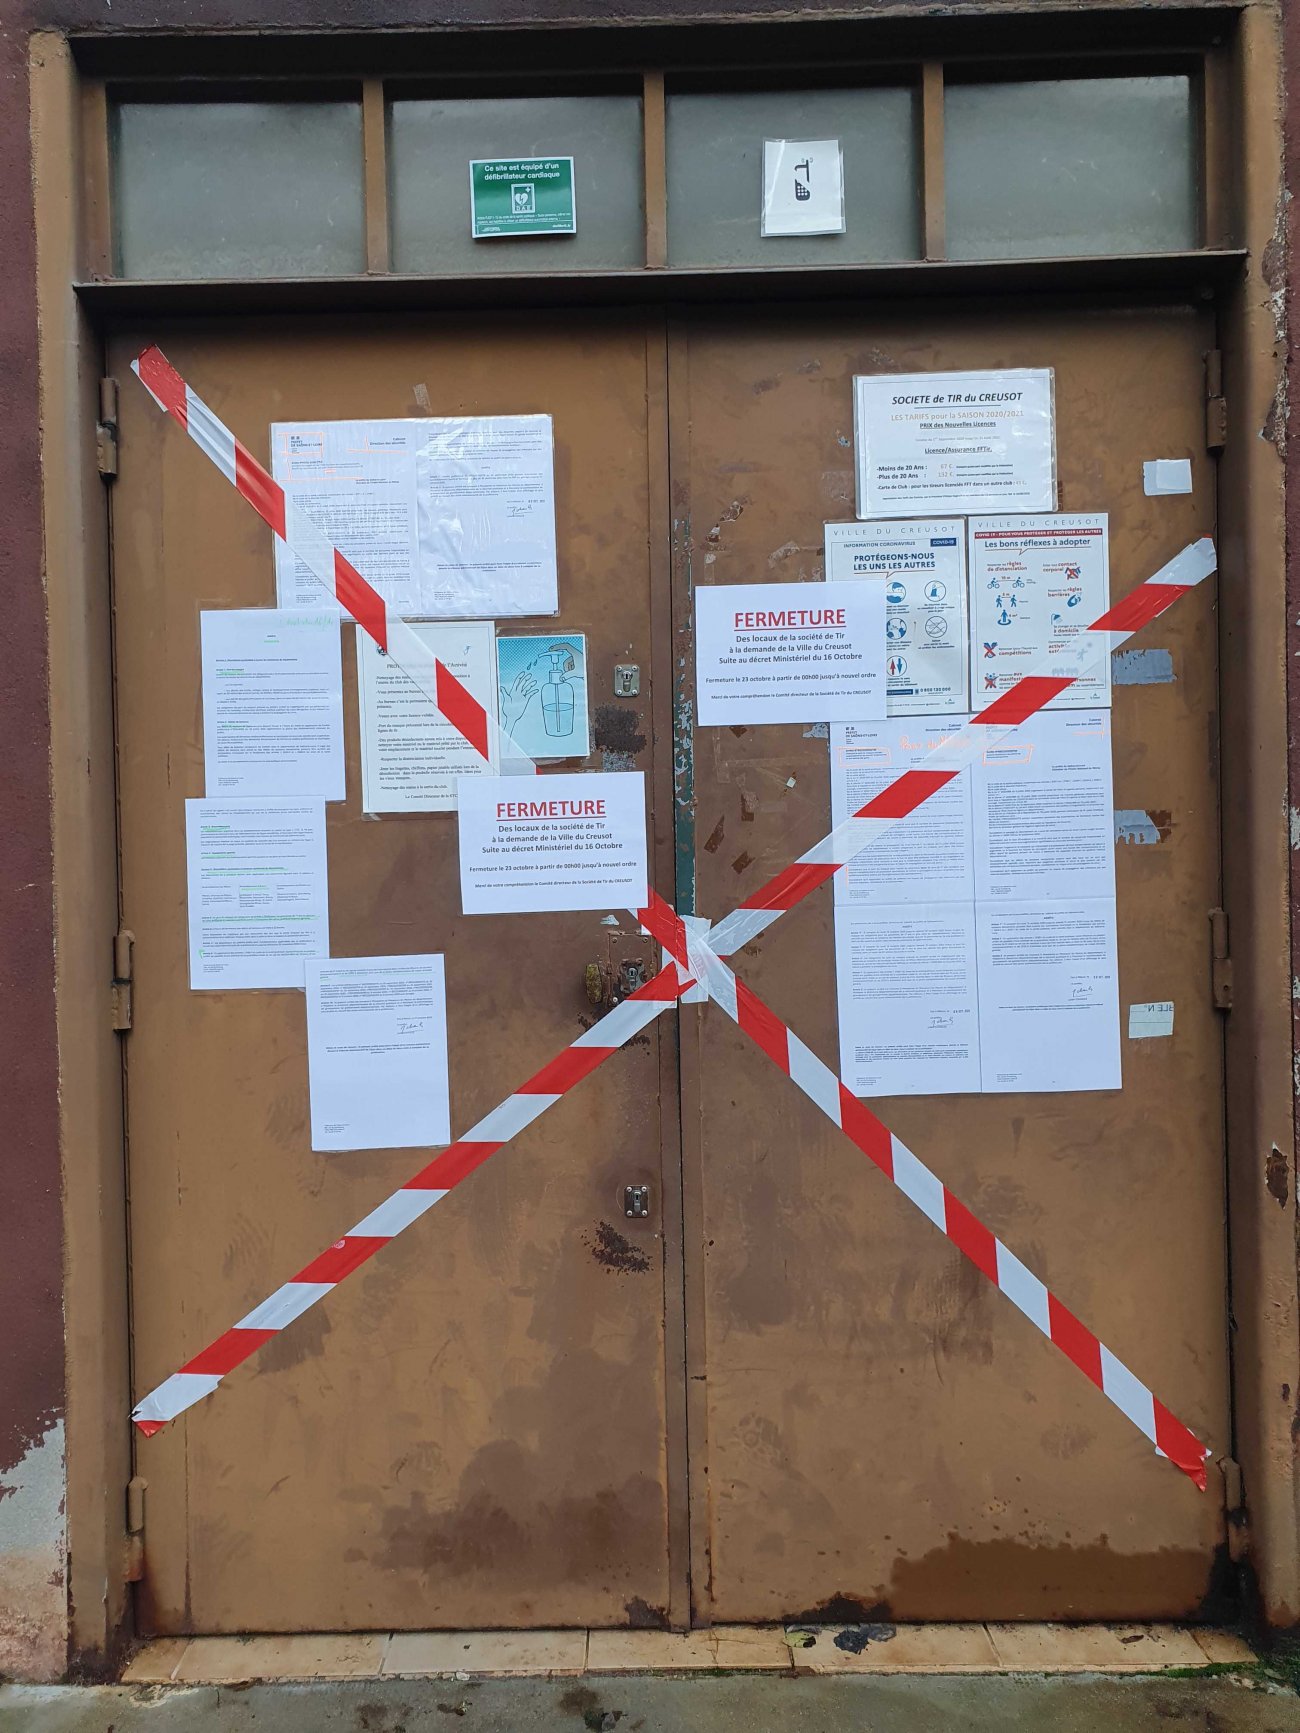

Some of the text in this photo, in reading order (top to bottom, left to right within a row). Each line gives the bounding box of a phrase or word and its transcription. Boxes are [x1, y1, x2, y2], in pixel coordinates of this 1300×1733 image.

[521, 163, 542, 172] équipé
[485, 172, 525, 180] défibrillateur
[892, 392, 1023, 405] SOCIETE de TIR du CREUSOT
[931, 413, 947, 421] pour
[958, 411, 984, 419] SAISON
[986, 410, 1024, 418] 2020/2021
[1045, 518, 1099, 526] CREUSOT
[1060, 538, 1090, 547] adopter
[854, 553, 934, 562] PROTÉGEONS-NOUS
[869, 562, 886, 570] UNS
[734, 608, 846, 628] FERMETURE
[752, 634, 777, 642] locaux
[798, 632, 823, 641] société
[719, 656, 737, 664] Suite
[749, 655, 771, 663] décret
[773, 654, 811, 662] Ministériel
[496, 799, 606, 818] FERMETURE
[515, 824, 539, 832] locaux
[560, 822, 584, 830] société
[586, 832, 612, 840] Creusot
[595, 842, 623, 850] Octobre
